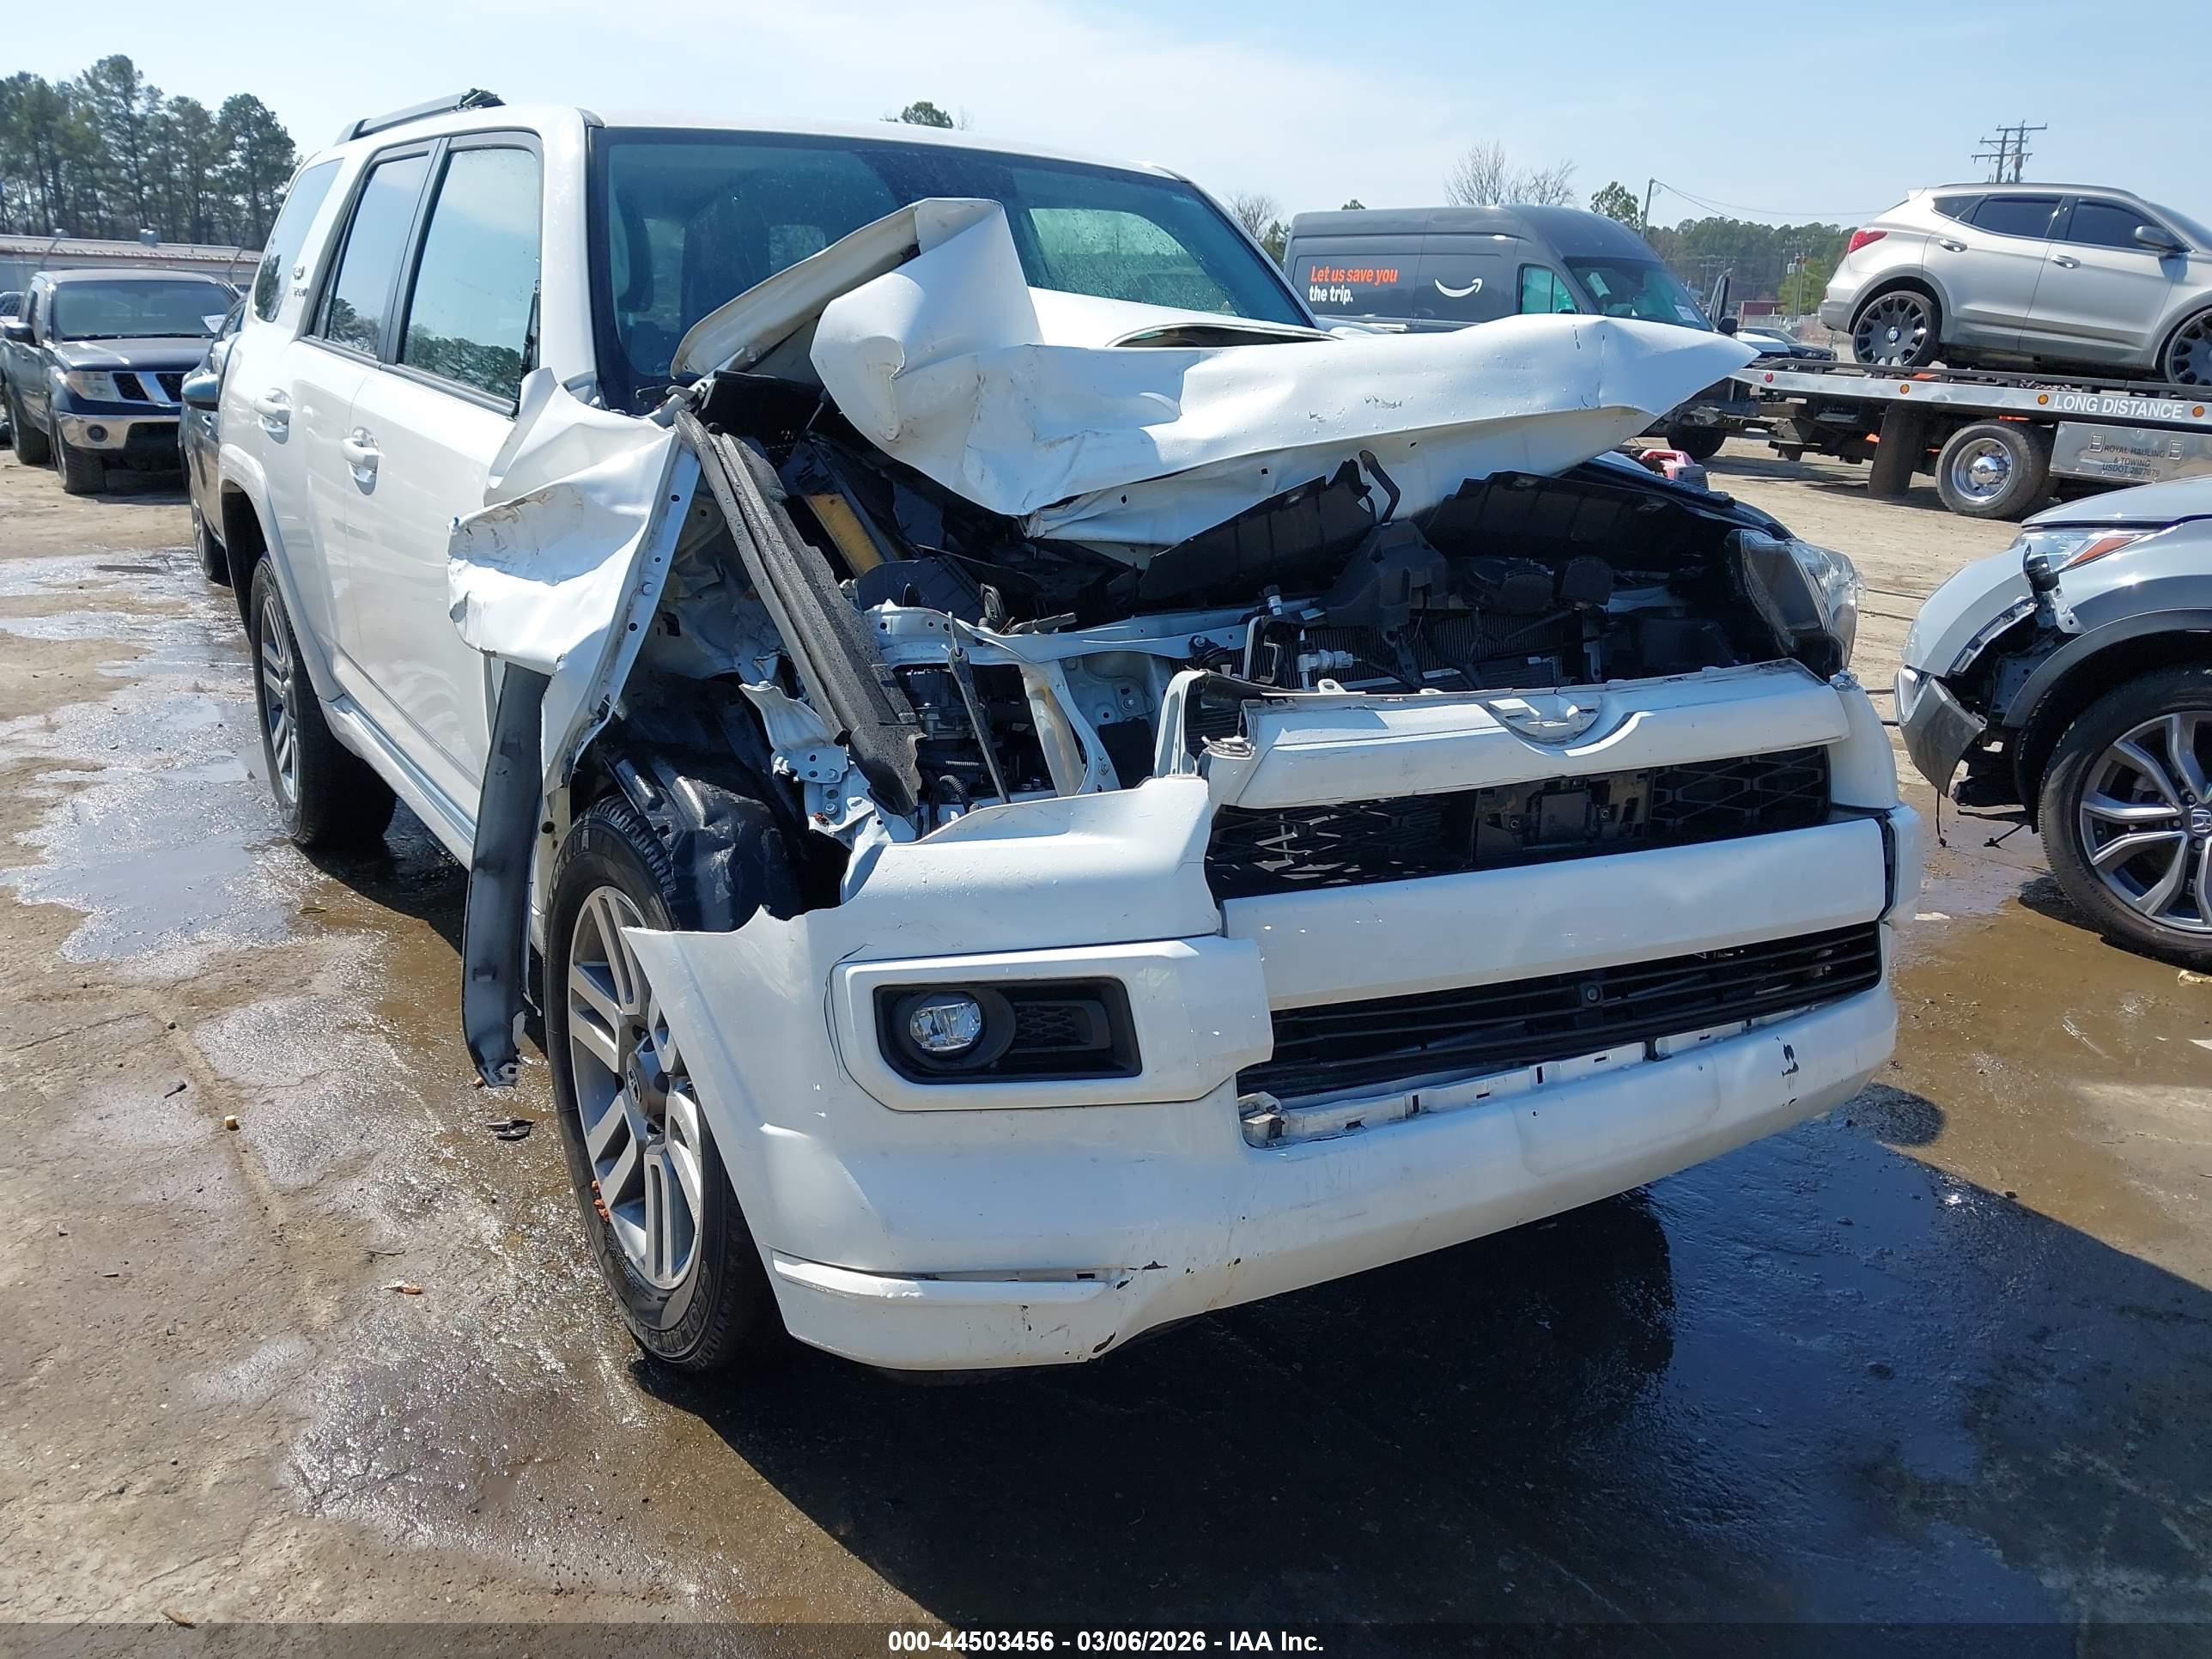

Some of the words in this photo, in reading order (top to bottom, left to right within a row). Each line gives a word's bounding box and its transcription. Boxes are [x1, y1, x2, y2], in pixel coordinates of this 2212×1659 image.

[1311, 265, 1330, 283] Let
[1332, 269, 1346, 283] us
[1346, 269, 1374, 283] save
[1374, 269, 1399, 286] you
[1309, 285, 1328, 302] the
[1329, 284, 1353, 306] trip.
[2053, 395, 2098, 412] LONG
[2101, 398, 2184, 419] DISTANCE
[2104, 445, 2129, 454] ROYAL
[2130, 447, 2165, 458] HAULING
[2102, 465, 2129, 473] USDOT
[2121, 457, 2151, 468] TOWING
